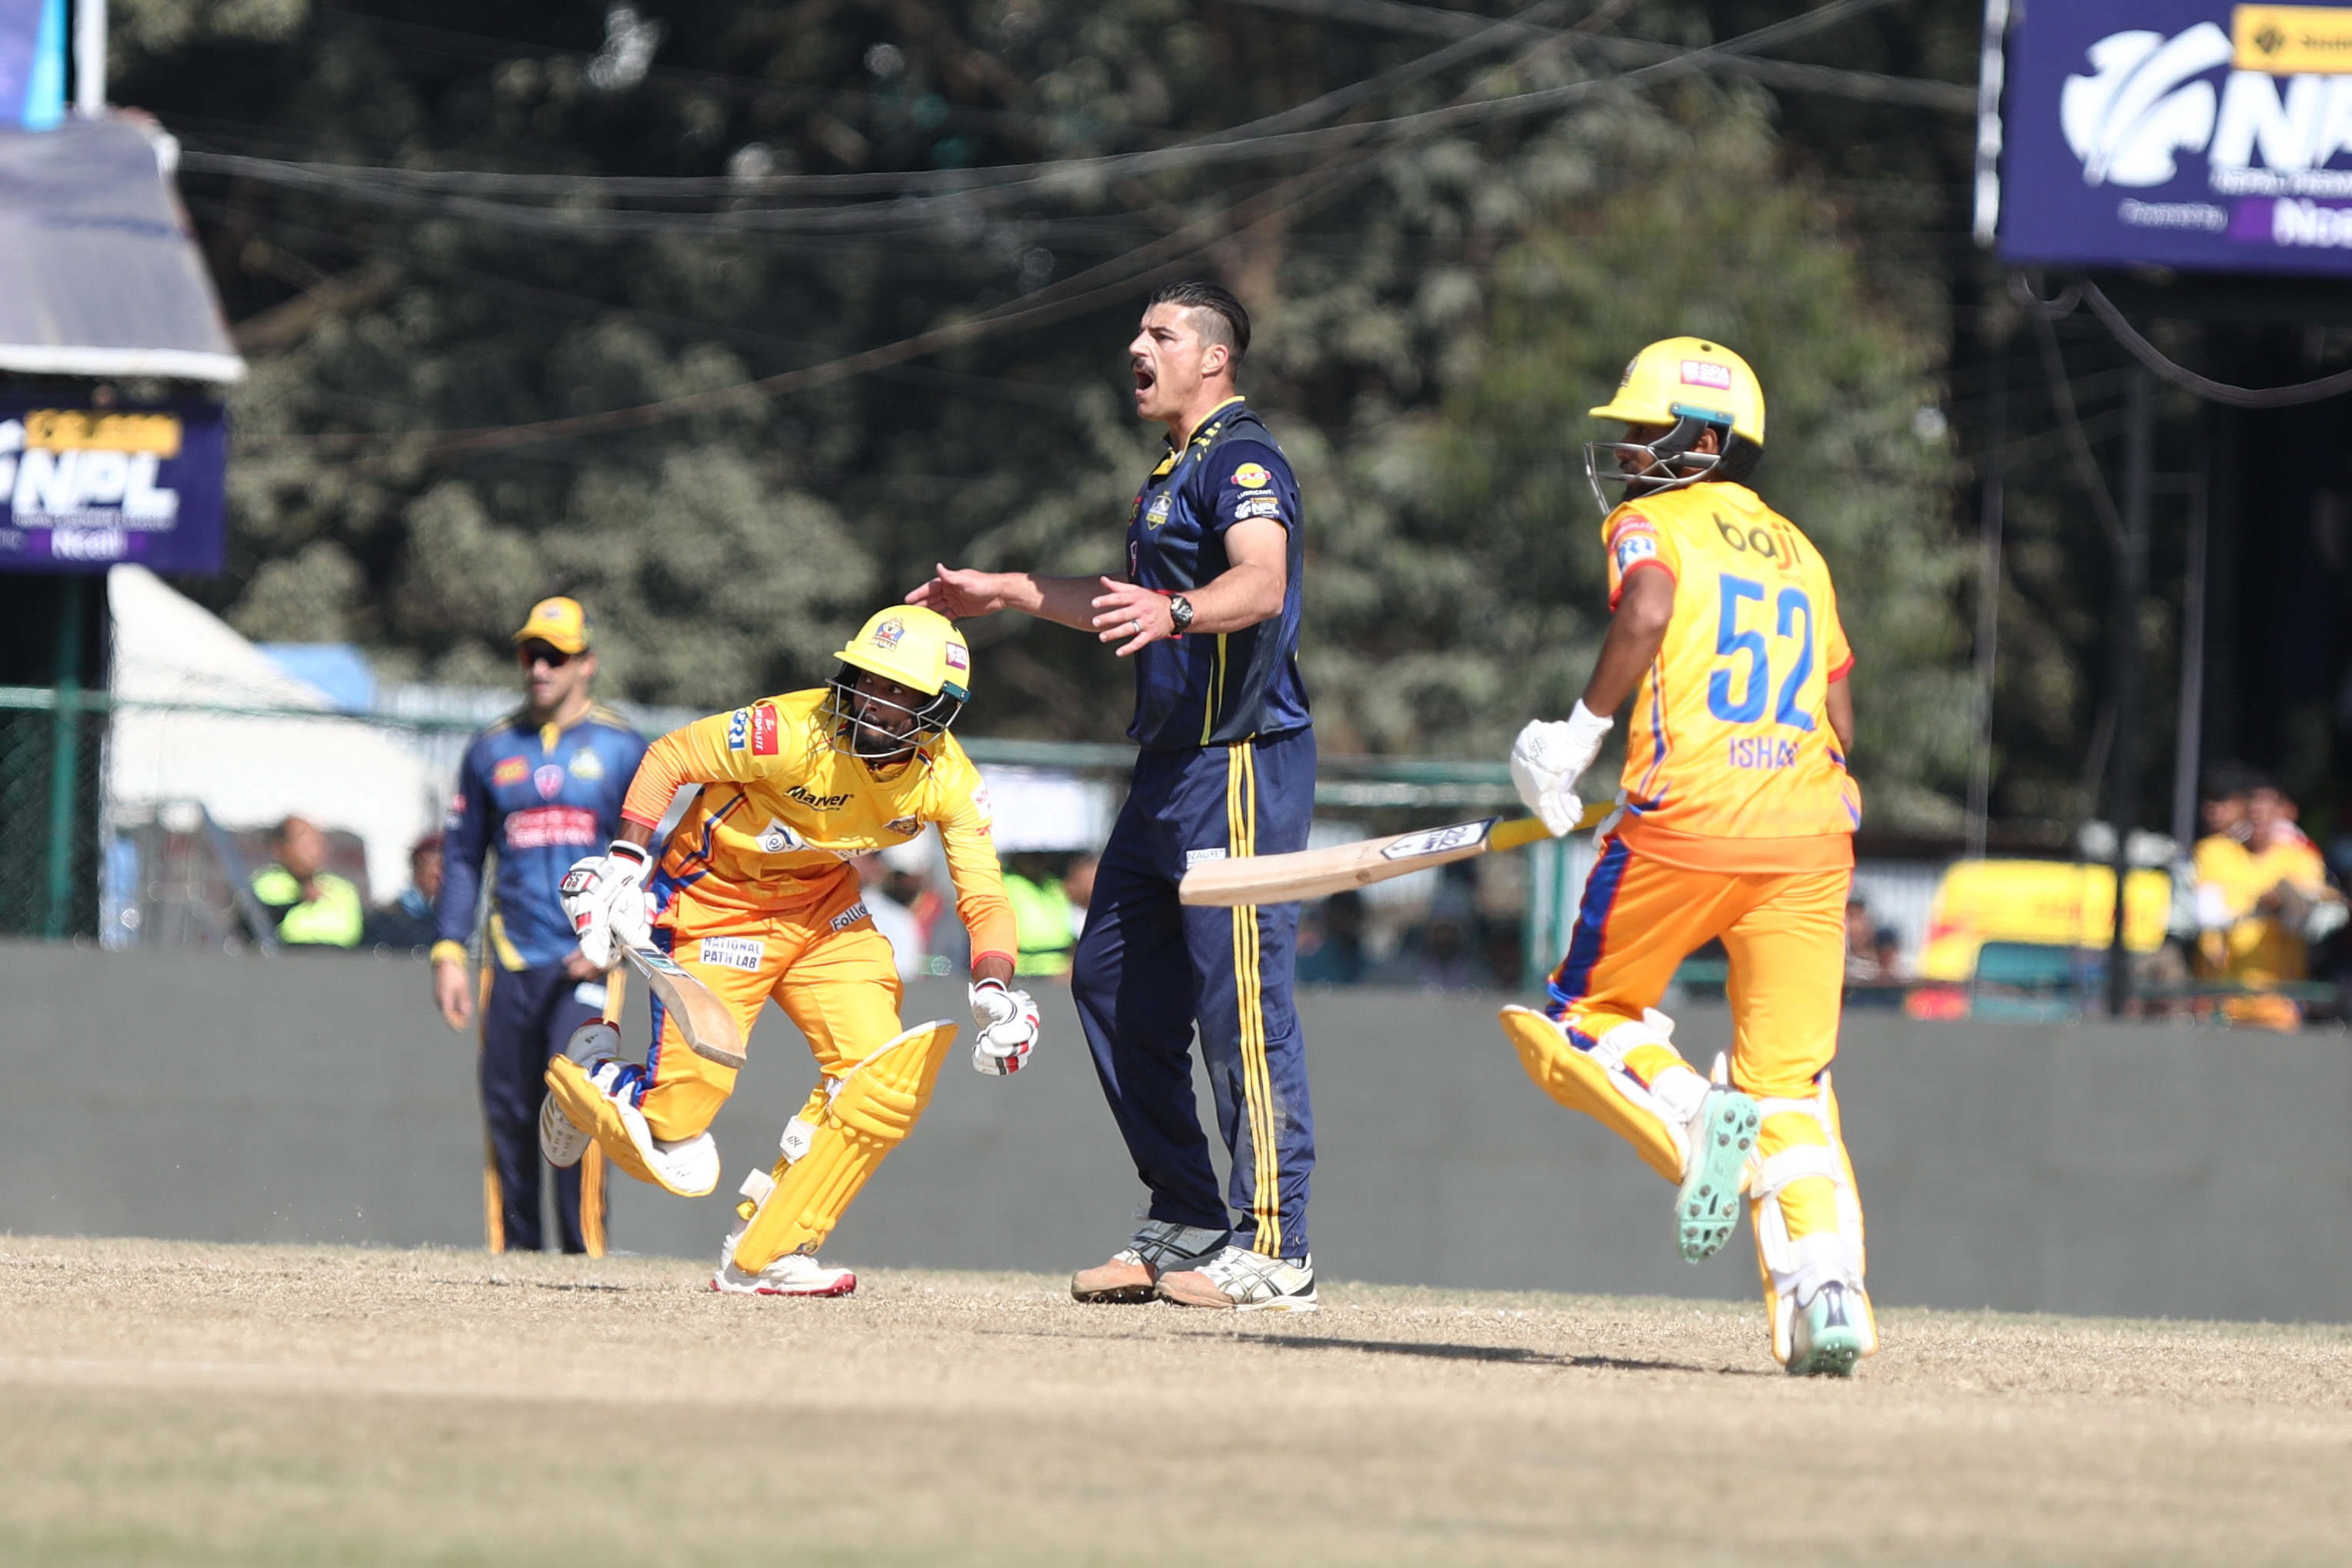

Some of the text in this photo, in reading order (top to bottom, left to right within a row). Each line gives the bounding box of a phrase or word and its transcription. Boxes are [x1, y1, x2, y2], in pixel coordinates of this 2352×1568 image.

[11, 448, 182, 515] NPL
[1251, 502, 1280, 514] NPL
[1712, 511, 1802, 571] baji
[1707, 572, 1818, 732] 52
[785, 785, 850, 807] Marvel
[704, 936, 761, 955] NATIONAL
[703, 950, 757, 970] PATH LAB
